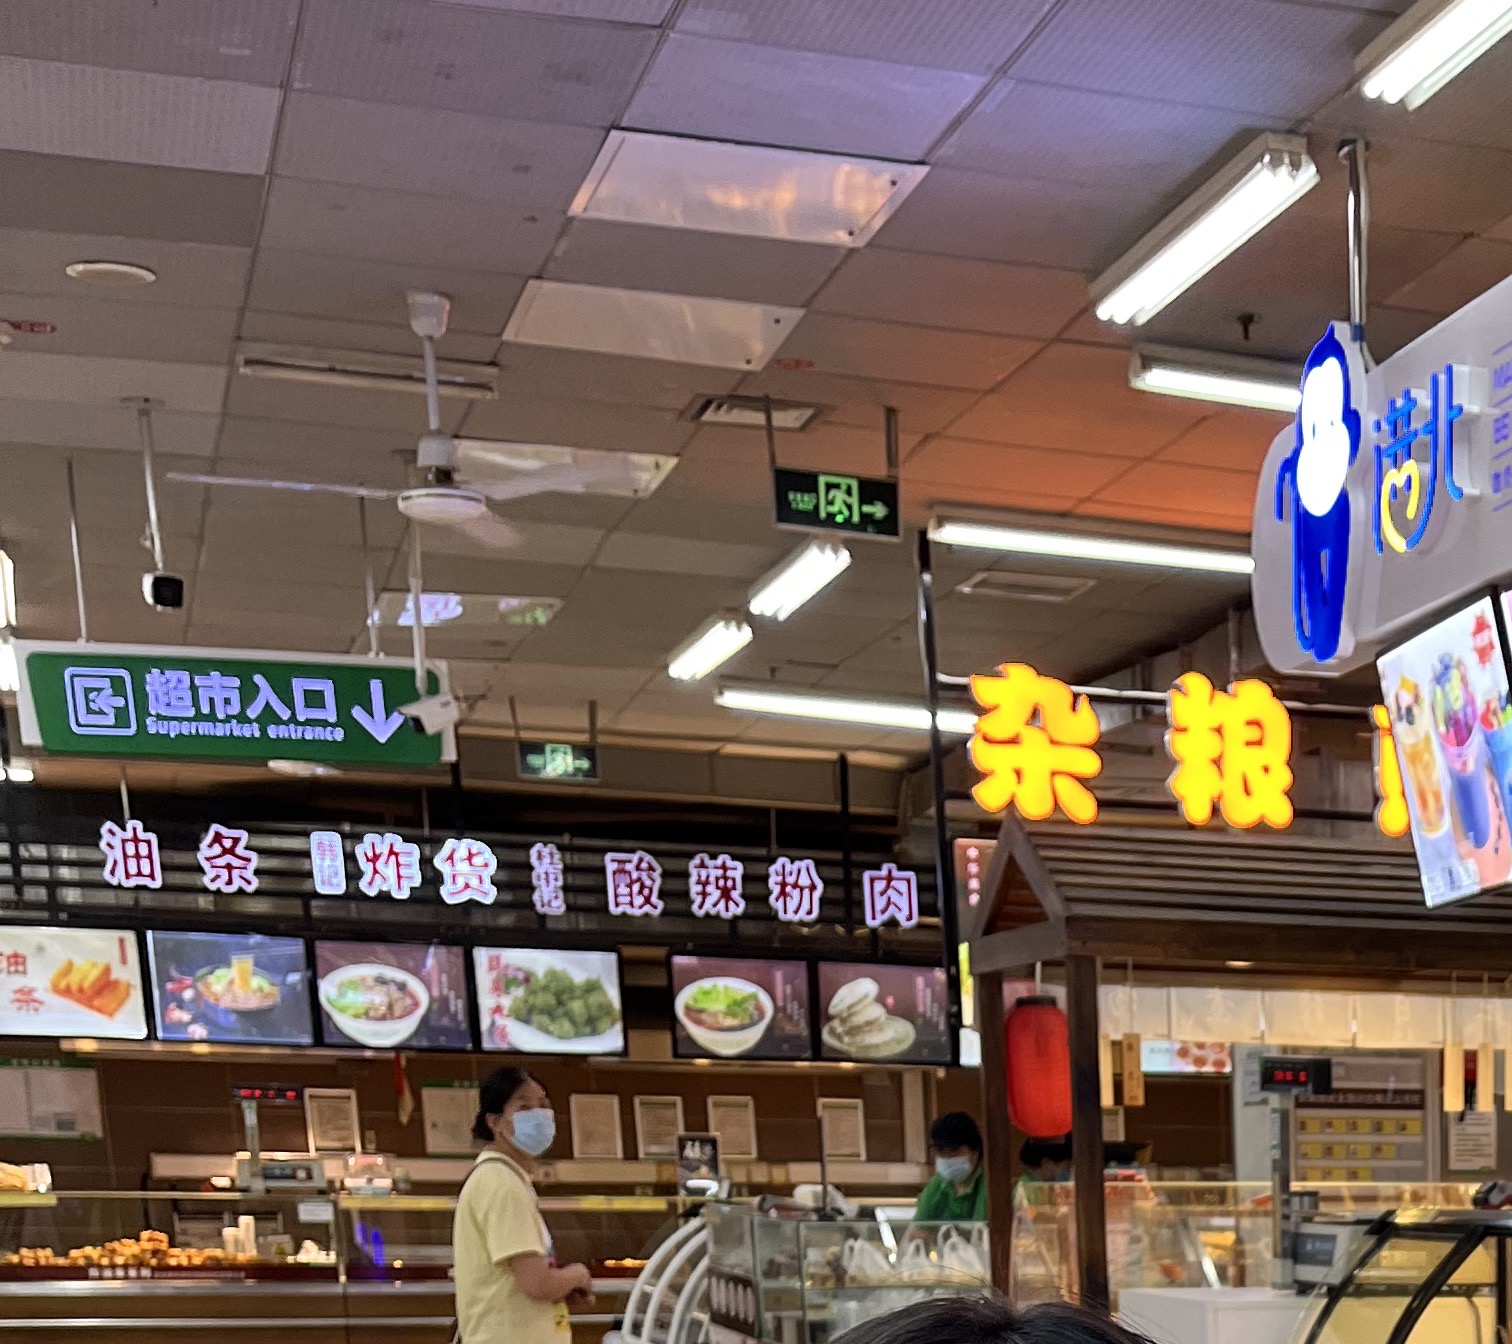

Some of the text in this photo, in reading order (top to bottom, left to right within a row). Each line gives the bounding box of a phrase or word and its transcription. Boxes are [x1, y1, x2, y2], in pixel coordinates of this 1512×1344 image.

[1371, 362, 1464, 555] 满北
[145, 667, 338, 723] 超市入口
[145, 716, 345, 743] Supermarket entrance
[101, 819, 260, 893] 油条
[358, 834, 498, 904] 炸货
[605, 851, 824, 923] 酸辣粉
[863, 864, 919, 928] 肉
